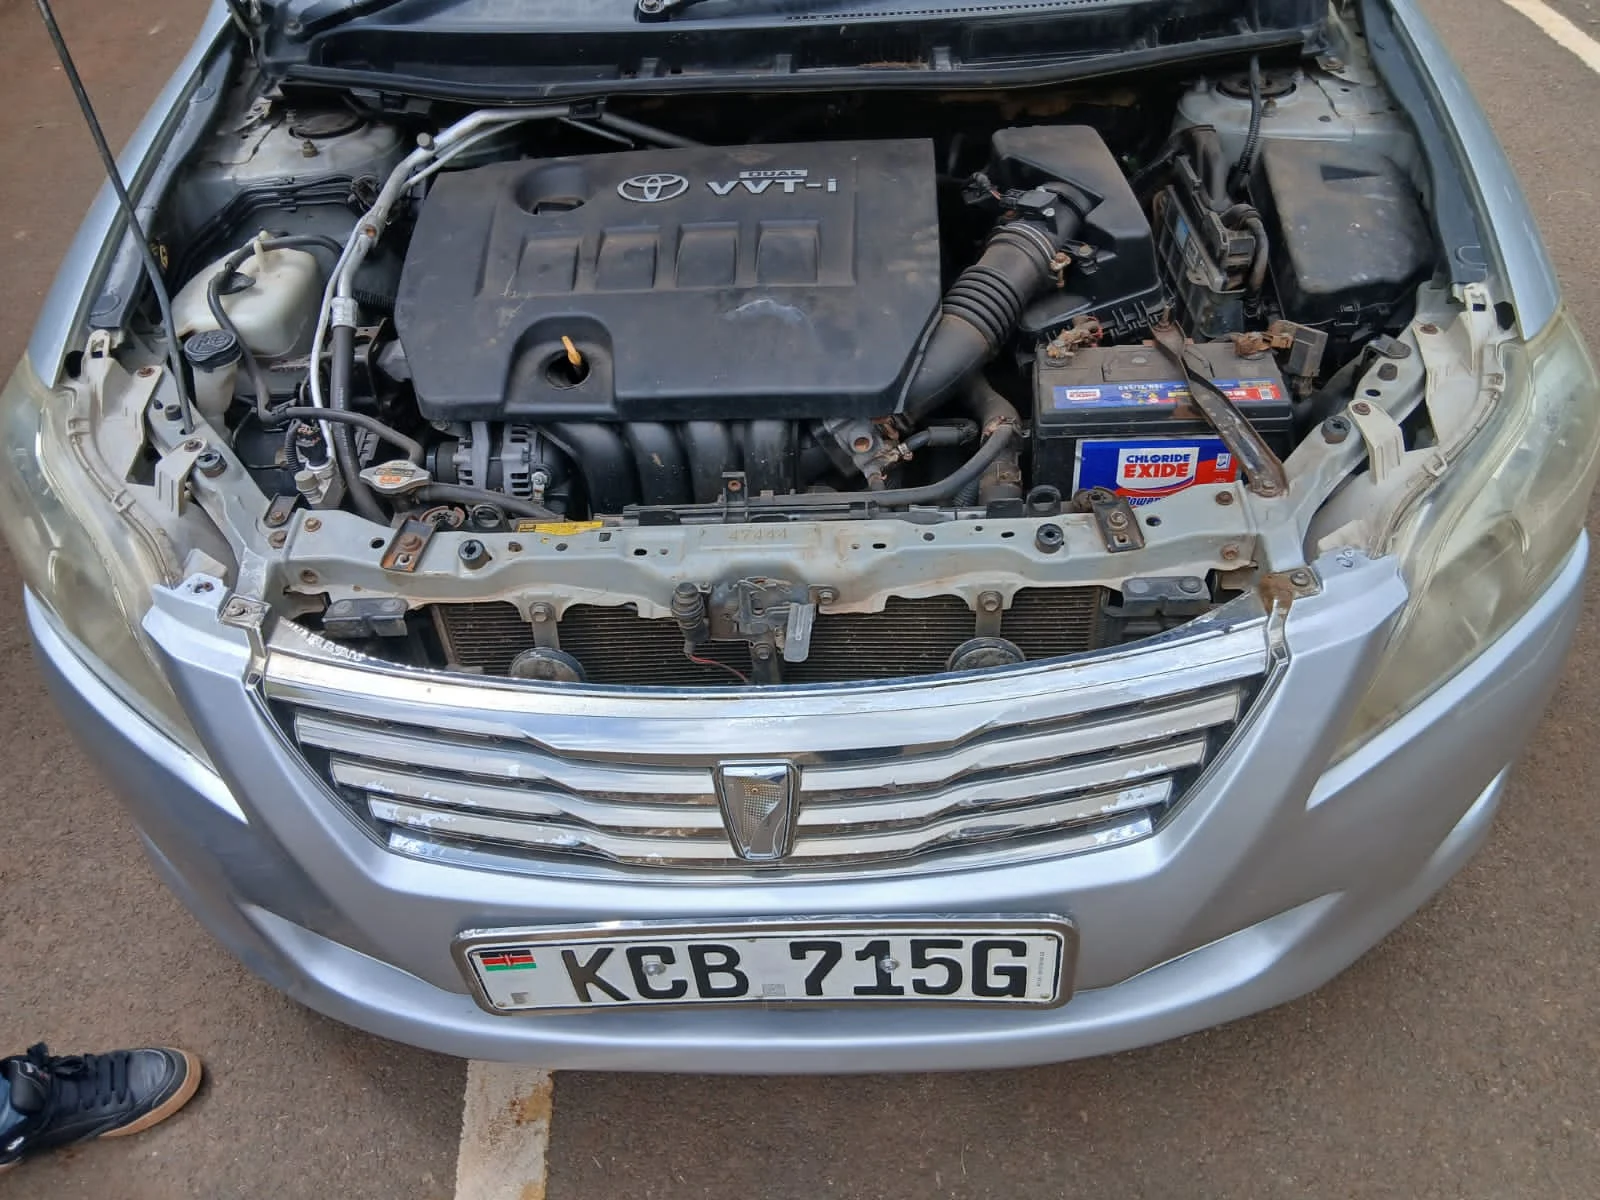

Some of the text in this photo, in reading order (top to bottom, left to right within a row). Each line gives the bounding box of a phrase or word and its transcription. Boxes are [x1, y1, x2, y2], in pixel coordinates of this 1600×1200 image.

[707, 178, 837, 195] VVT-i
[1126, 454, 1191, 463] CHLORIDE
[1124, 462, 1190, 478] EXIDE
[561, 944, 749, 1002] KCB
[789, 939, 1027, 997] 715G
